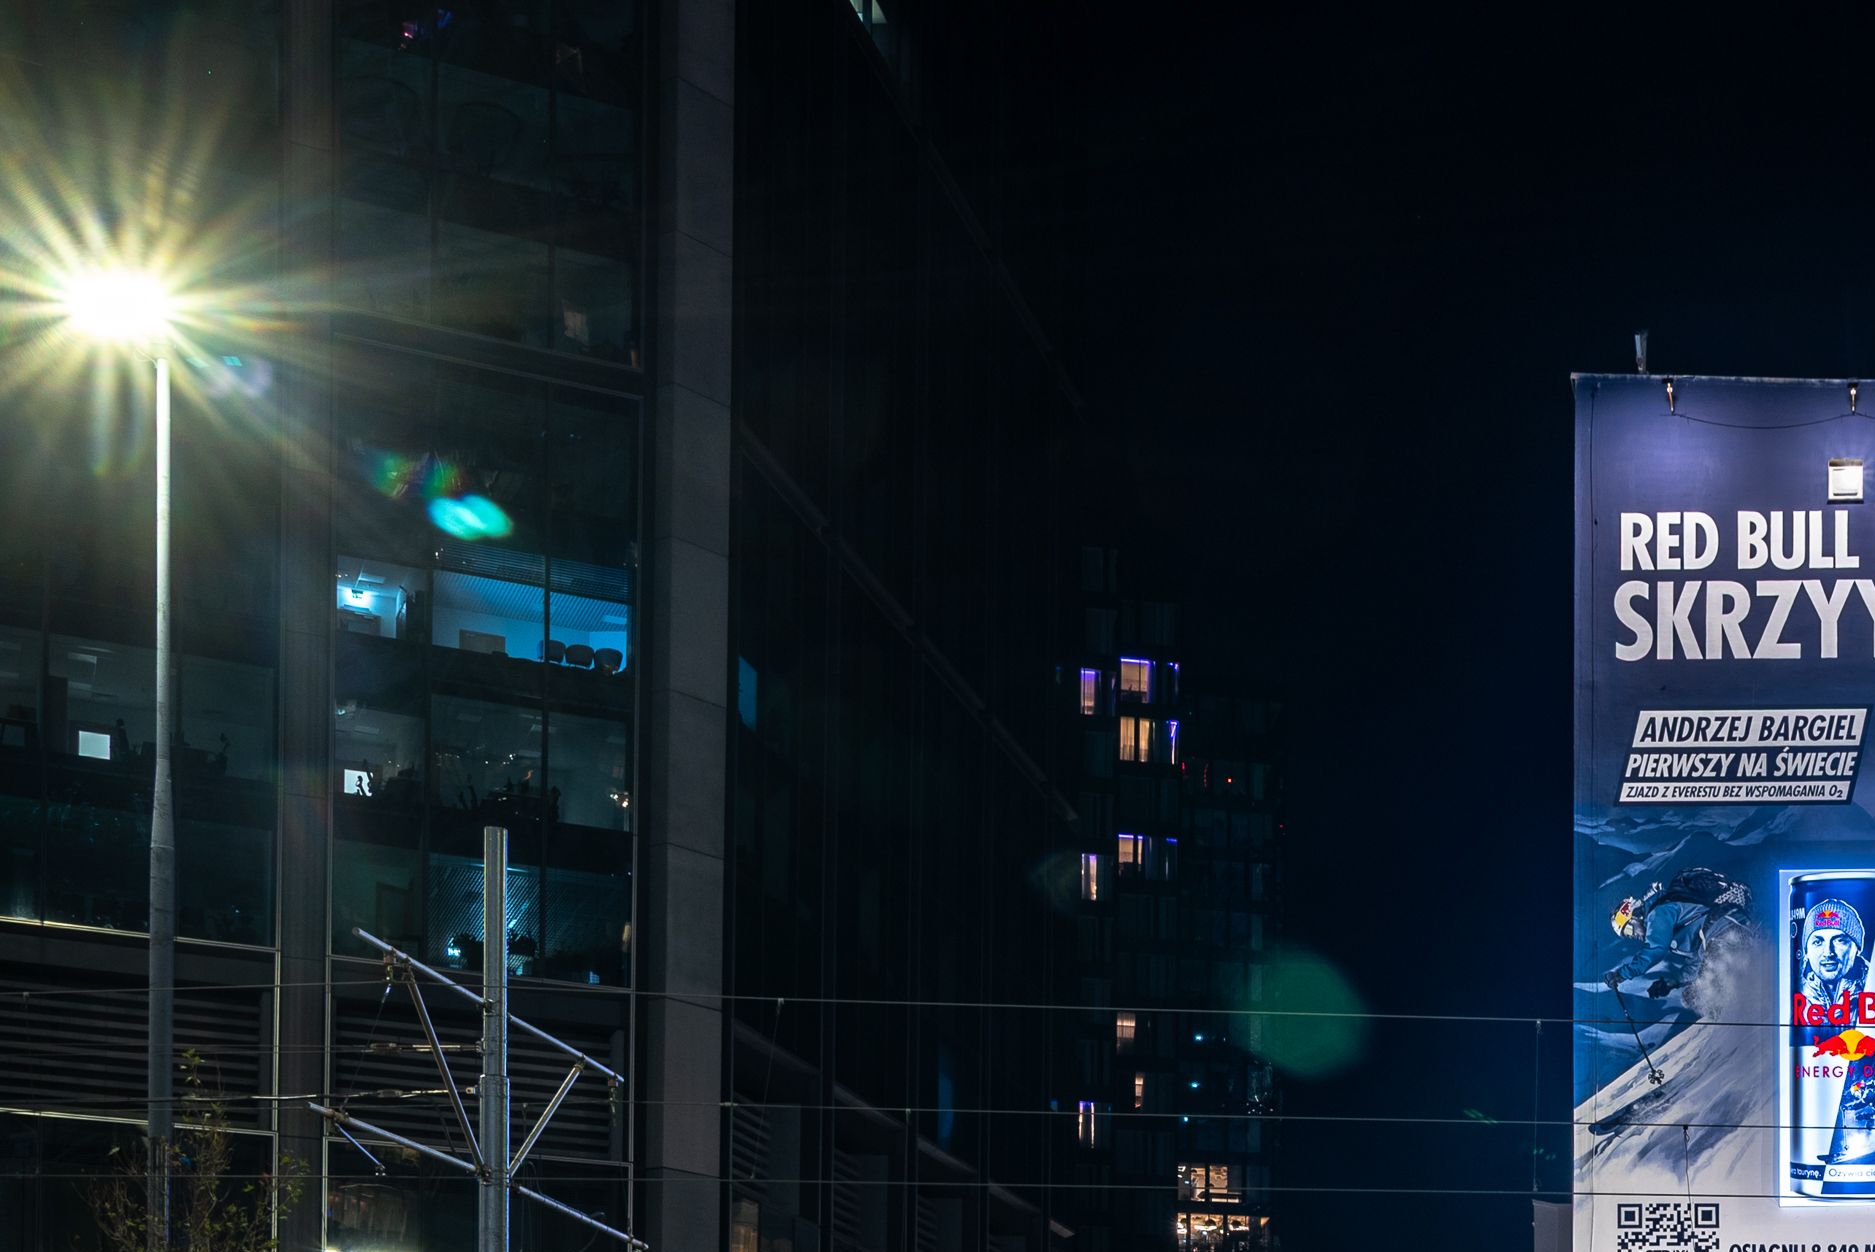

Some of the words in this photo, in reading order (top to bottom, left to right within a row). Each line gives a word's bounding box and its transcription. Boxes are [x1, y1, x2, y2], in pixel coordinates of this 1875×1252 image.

[1620, 511, 1719, 570] RED
[1737, 509, 1860, 570] BULL
[1640, 716, 1752, 742] ANDRZEJ
[1758, 714, 1857, 741] BARGIEL
[1625, 753, 1736, 777] PIERWSZY
[1736, 752, 1767, 777] NA
[1774, 746, 1857, 777] ŚWIECIE
[1626, 786, 1659, 798] ZJAZD
[1662, 786, 1671, 798] Z
[1672, 785, 1720, 798] EVERESTU
[1723, 785, 1742, 797] BEZ
[1744, 784, 1826, 797] WSPOMAGANIA
[1793, 990, 1850, 1026] Red
[1795, 1065, 1856, 1078] ENERGY
